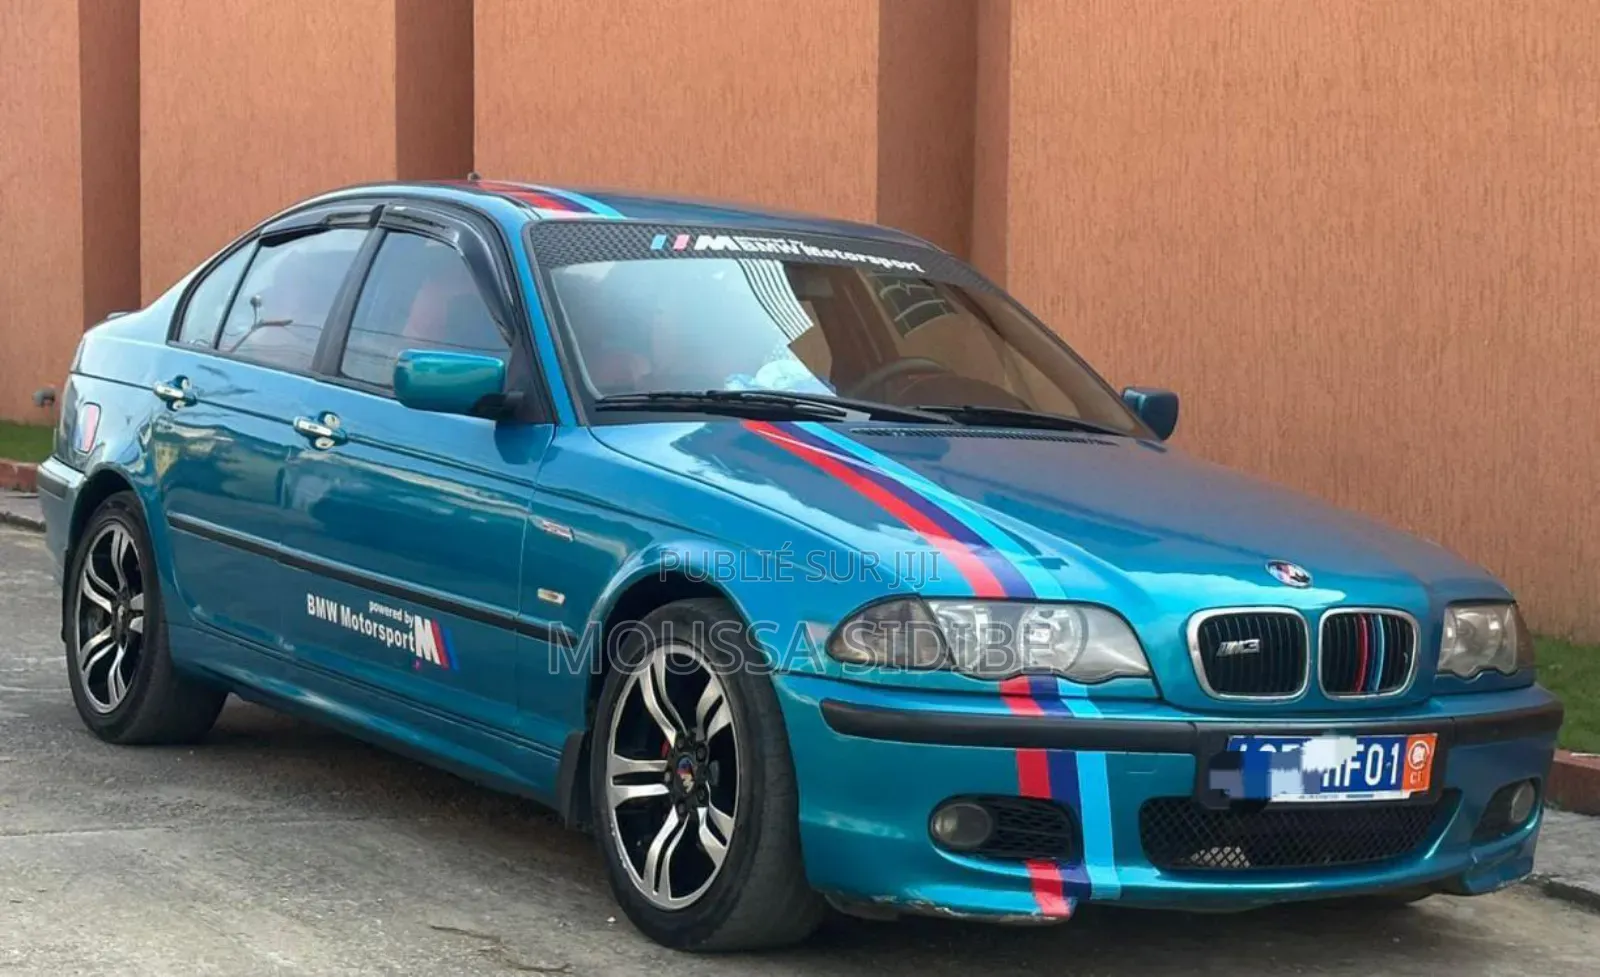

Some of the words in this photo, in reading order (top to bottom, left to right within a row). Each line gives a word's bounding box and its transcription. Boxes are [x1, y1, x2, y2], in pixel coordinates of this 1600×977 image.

[694, 235, 741, 251] M
[801, 243, 925, 273] Motorsport
[306, 593, 338, 624] BMW
[340, 605, 415, 652] Motorsport
[368, 601, 402, 621] powered
[404, 609, 414, 628] by
[415, 615, 442, 666] M
